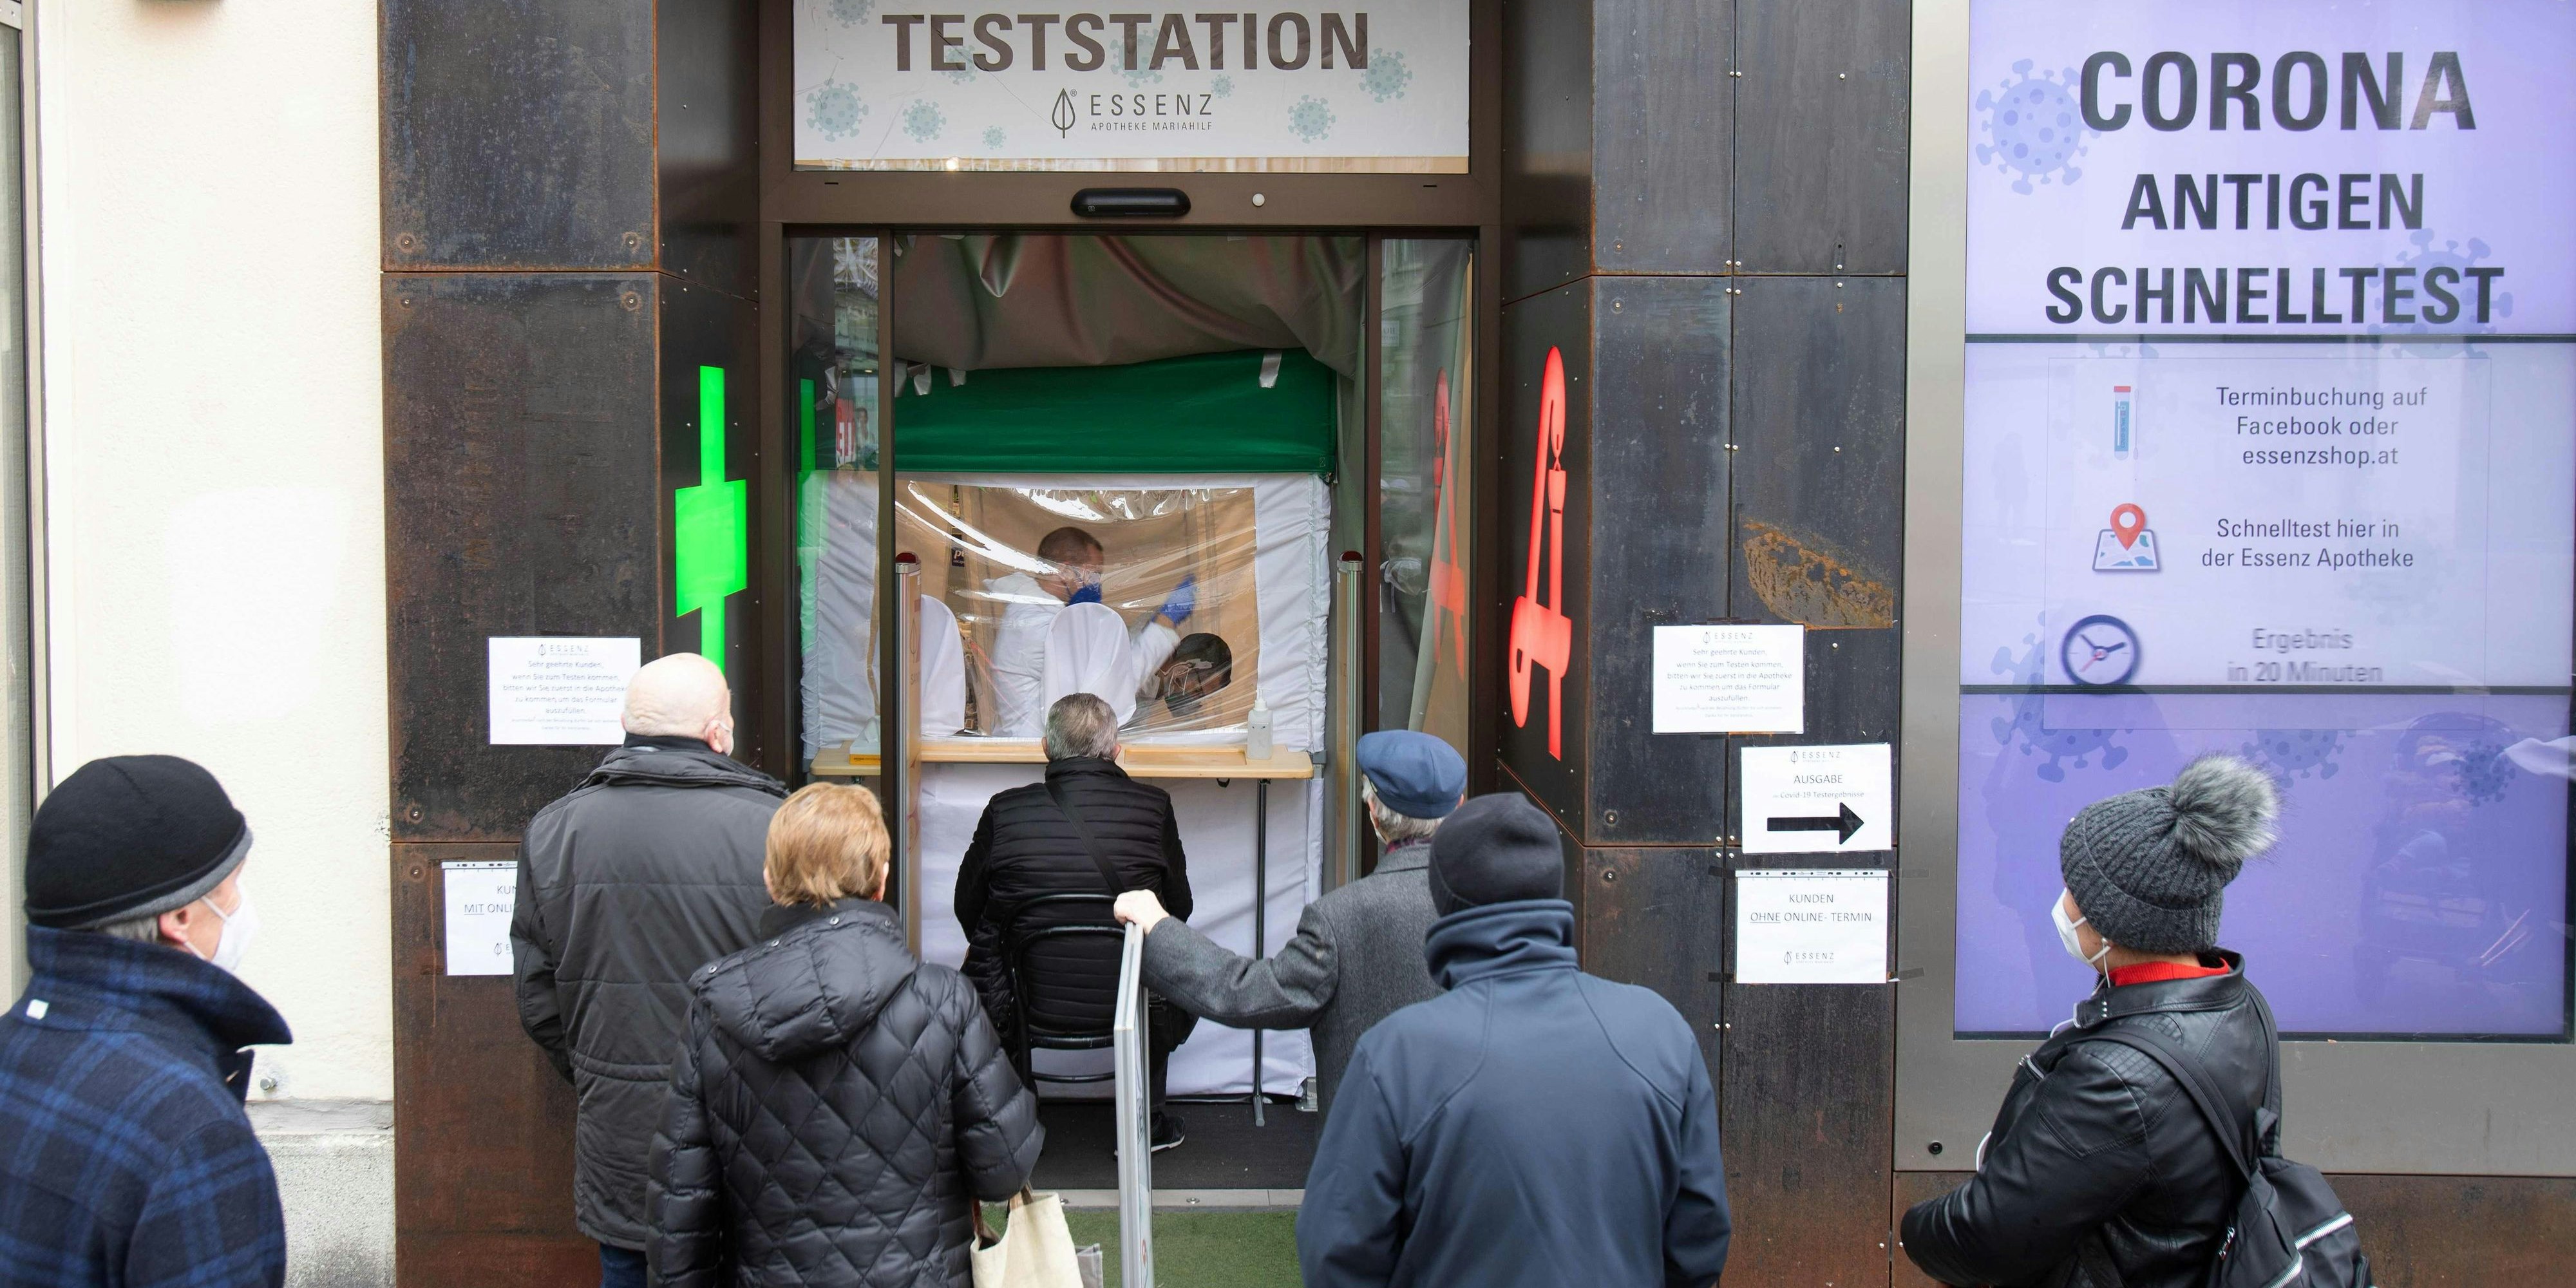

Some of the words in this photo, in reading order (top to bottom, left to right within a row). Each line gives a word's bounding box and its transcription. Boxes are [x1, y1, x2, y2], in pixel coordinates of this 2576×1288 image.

[882, 12, 1368, 71] TESTSTATION
[2080, 51, 2476, 131] CORONA
[1091, 94, 1211, 116] ESSENZ
[1092, 122, 1146, 131] APOTHEKE
[1153, 122, 1211, 130] MARIAHILF
[2121, 173, 2424, 231] ANTIGEN
[2045, 266, 2505, 325] SCHNELLTEST
[2216, 387, 2383, 410] Terminbuchung
[2393, 387, 2427, 406] auf
[2238, 416, 2342, 435] Facebook
[2350, 417, 2398, 435] oder
[2243, 447, 2398, 468] essenzshop.at
[2217, 518, 2331, 538] Schnelltest
[2338, 519, 2375, 538] hier
[2383, 519, 2398, 538] in
[2202, 548, 2234, 567] der
[2242, 548, 2310, 567] Essenz
[2317, 548, 2413, 571] Apotheke
[2253, 629, 2353, 654] Ergebnis
[2228, 662, 2248, 681] in
[2255, 663, 2280, 681] 20
[2287, 662, 2383, 682] Minuten
[1794, 775, 1842, 784] AUSGABE
[1814, 791, 1864, 799] Testergebnisse
[464, 904, 484, 913] MIT
[1789, 894, 1833, 903] KUNDEN
[1750, 912, 1780, 922] OHNE
[1784, 913, 1827, 922] ONLINE-
[1831, 912, 1871, 922] TERMIN
